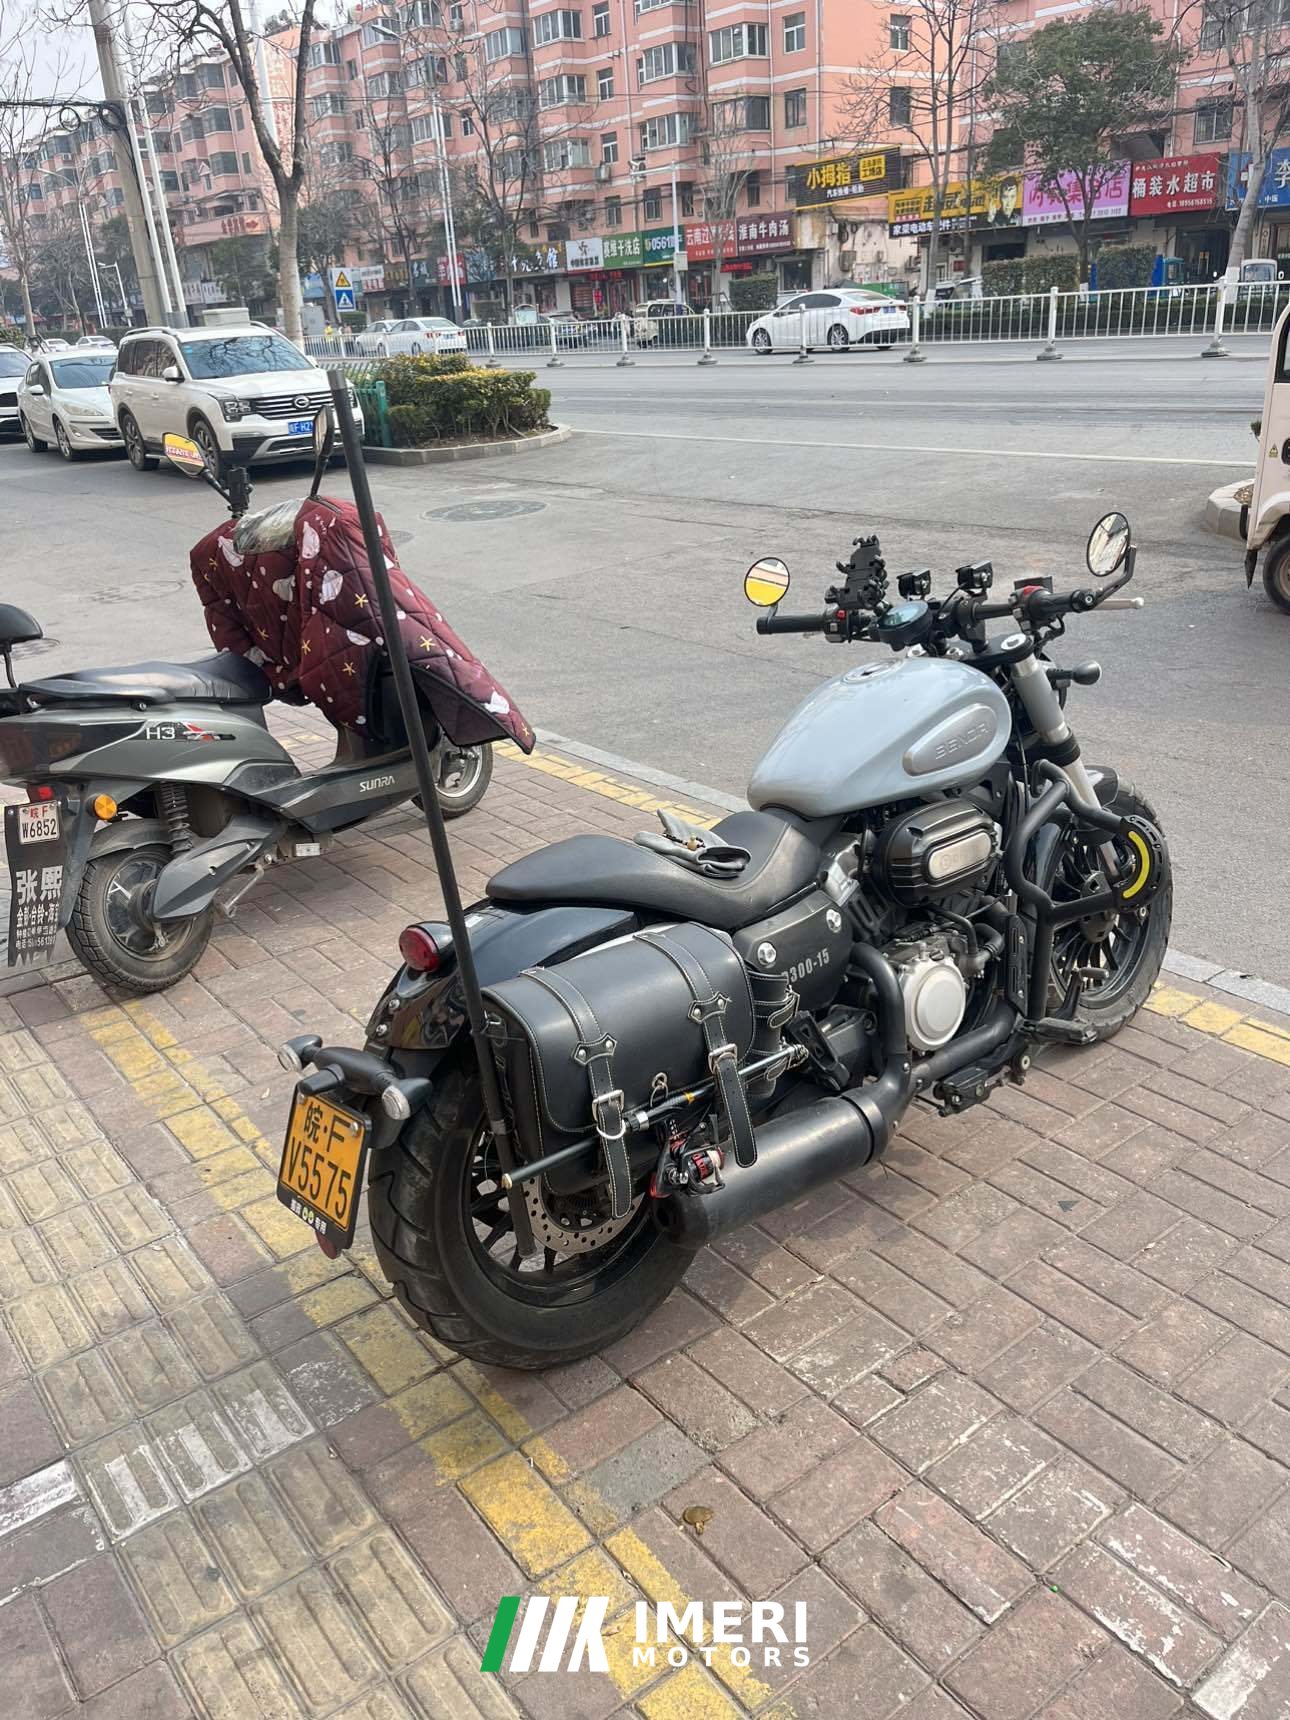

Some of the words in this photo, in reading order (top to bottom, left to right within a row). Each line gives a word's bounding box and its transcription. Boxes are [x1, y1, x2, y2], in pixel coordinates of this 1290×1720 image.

[806, 162, 851, 189] 小拇指
[1132, 171, 1216, 199] 桶装水超市
[738, 220, 789, 241] 淮南牛肉汤
[145, 727, 175, 740] H3
[22, 818, 57, 838] W6852
[288, 1135, 351, 1220] V5575
